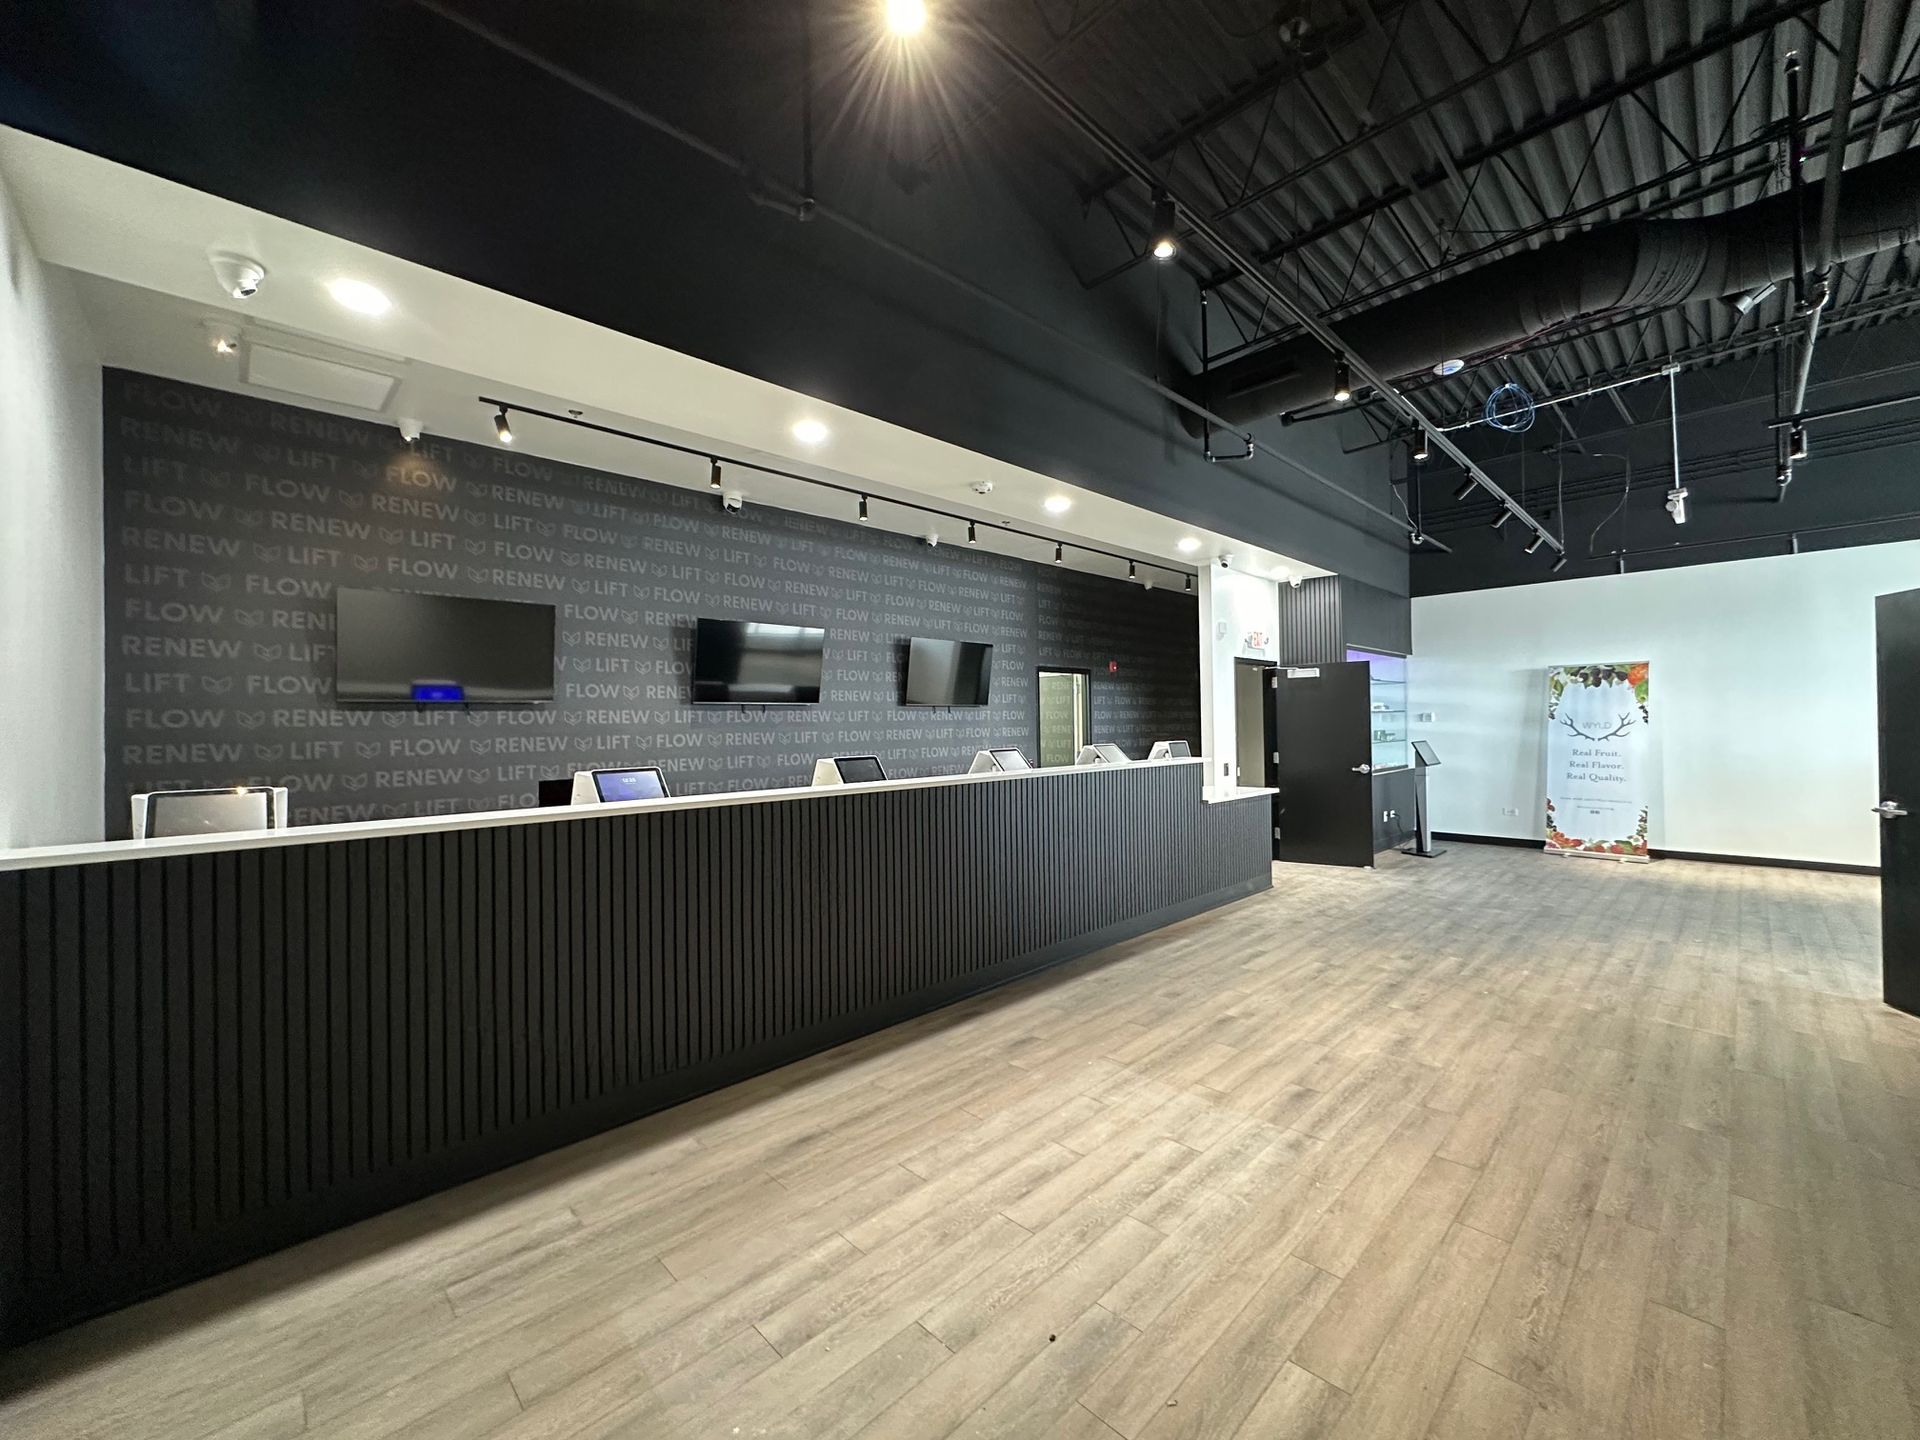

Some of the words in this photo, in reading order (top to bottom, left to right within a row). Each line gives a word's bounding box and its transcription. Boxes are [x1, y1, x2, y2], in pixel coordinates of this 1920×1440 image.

[120, 416, 241, 455] RENEW
[288, 447, 341, 473] LIFT
[386, 465, 457, 492] FLOW
[491, 484, 564, 511] RENEW
[593, 502, 626, 521] LIFT
[653, 514, 699, 534] FLOW
[723, 526, 773, 546] RENEW
[792, 538, 815, 553] LIFT
[835, 546, 867, 562] FLOW
[883, 555, 919, 571] RENEW
[932, 564, 950, 576] LIFT
[964, 569, 988, 583] FLOW
[1000, 576, 1027, 589] RENEW
[123, 454, 189, 481] LIFT
[244, 473, 330, 502] FLOW
[371, 493, 459, 522] RENEW
[493, 513, 532, 533] LIFT
[564, 524, 617, 545] FLOW
[645, 537, 702, 558] RENEW
[724, 549, 751, 565] LIFT
[773, 557, 810, 574] FLOW
[828, 566, 868, 582] RENEW
[884, 575, 903, 587] LIFT
[919, 580, 946, 594] FLOW
[959, 586, 989, 600] RENEW
[1001, 593, 1015, 604] LIFT
[124, 490, 224, 521] FLOW
[272, 510, 372, 540] RENEW
[411, 530, 456, 550] LIFT
[493, 541, 554, 563] FLOW
[583, 553, 646, 574] RENEW
[672, 565, 701, 581] LIFT
[725, 572, 766, 589] FLOW
[785, 581, 829, 597] RENEW
[846, 589, 867, 602] LIFT
[884, 594, 914, 608] FLOW
[928, 600, 960, 613] RENEW
[972, 606, 988, 617] LIFT
[1001, 610, 1023, 621] FLOW
[121, 526, 242, 557] RENEW
[289, 546, 342, 568] LIFT
[387, 557, 458, 580] FLOW
[492, 569, 565, 591] RENEW
[594, 580, 627, 597] LIFT
[654, 588, 700, 605] FLOW
[724, 595, 773, 612] RENEW
[793, 603, 816, 616] LIFT
[835, 608, 868, 622] FLOW
[884, 613, 919, 627] RENEW
[933, 619, 951, 630] LIFT
[965, 623, 989, 634] FLOW
[1000, 627, 1028, 638] RENEW
[124, 563, 190, 587] LIFT
[245, 575, 331, 598] FLOW
[125, 600, 225, 624] FLOW
[565, 604, 619, 622] FLOW
[584, 632, 647, 649] RENEW
[672, 638, 694, 651] LIF
[829, 628, 869, 642] RENEW
[122, 637, 243, 659] RENEW
[847, 650, 868, 661] LIFT
[1001, 644, 1016, 653] LIFT
[594, 659, 628, 673] LIFT
[1002, 660, 1024, 670] FLOW
[836, 670, 869, 681] FLOW
[1001, 677, 1028, 687] RENEW
[125, 673, 191, 693] LIFT
[246, 676, 332, 694] FLOW
[567, 684, 621, 698] FLOW
[830, 690, 870, 701] RENEW
[1002, 694, 1017, 703] LIFT
[126, 710, 226, 728] FLOW
[273, 710, 374, 727] RENEW
[413, 710, 457, 726] LIFT
[496, 711, 556, 725] FLOW
[584, 711, 648, 724] RENEW
[673, 711, 702, 723] LIFT
[727, 711, 767, 723] FLOW
[787, 711, 831, 722] RENEW
[848, 711, 869, 721] LIFT
[886, 711, 915, 721] FLOW
[929, 711, 962, 721] RENEW
[974, 711, 990, 720] LIFT
[1002, 711, 1025, 720] FLOW
[1582, 721, 1612, 730] WYLD
[123, 744, 244, 765] RENEW
[291, 742, 344, 760] LIFT
[389, 740, 459, 757] FLOW
[495, 737, 568, 753] RENEW
[595, 736, 629, 750] LIFT
[657, 734, 703, 748] FLOW
[726, 733, 775, 746] RENEW
[794, 732, 818, 744] LIFT
[837, 731, 870, 742] FLOW
[885, 730, 921, 741] RENEW
[935, 729, 952, 739] LIFT
[966, 728, 991, 738] FLOW
[1002, 728, 1029, 737] RENEW
[886, 749, 906, 760] LIFT
[921, 747, 949, 758] FLOW
[1595, 749, 1622, 757] Fruit.
[374, 769, 461, 788] RENEW
[495, 766, 535, 782] LIFT
[727, 756, 754, 769] LIFT
[776, 753, 813, 766] FLOW
[887, 768, 916, 780] FLOW
[930, 765, 962, 776] RENEW
[1569, 760, 1589, 768] Real
[1592, 761, 1624, 770] Flavor.
[1567, 772, 1586, 780] Real
[1589, 773, 1627, 784] Quality.
[673, 782, 703, 796] LIFT
[727, 778, 768, 792] FLOW
[293, 804, 374, 827] ENEW
[413, 798, 458, 816] LIFT
[496, 792, 537, 808] FLO
